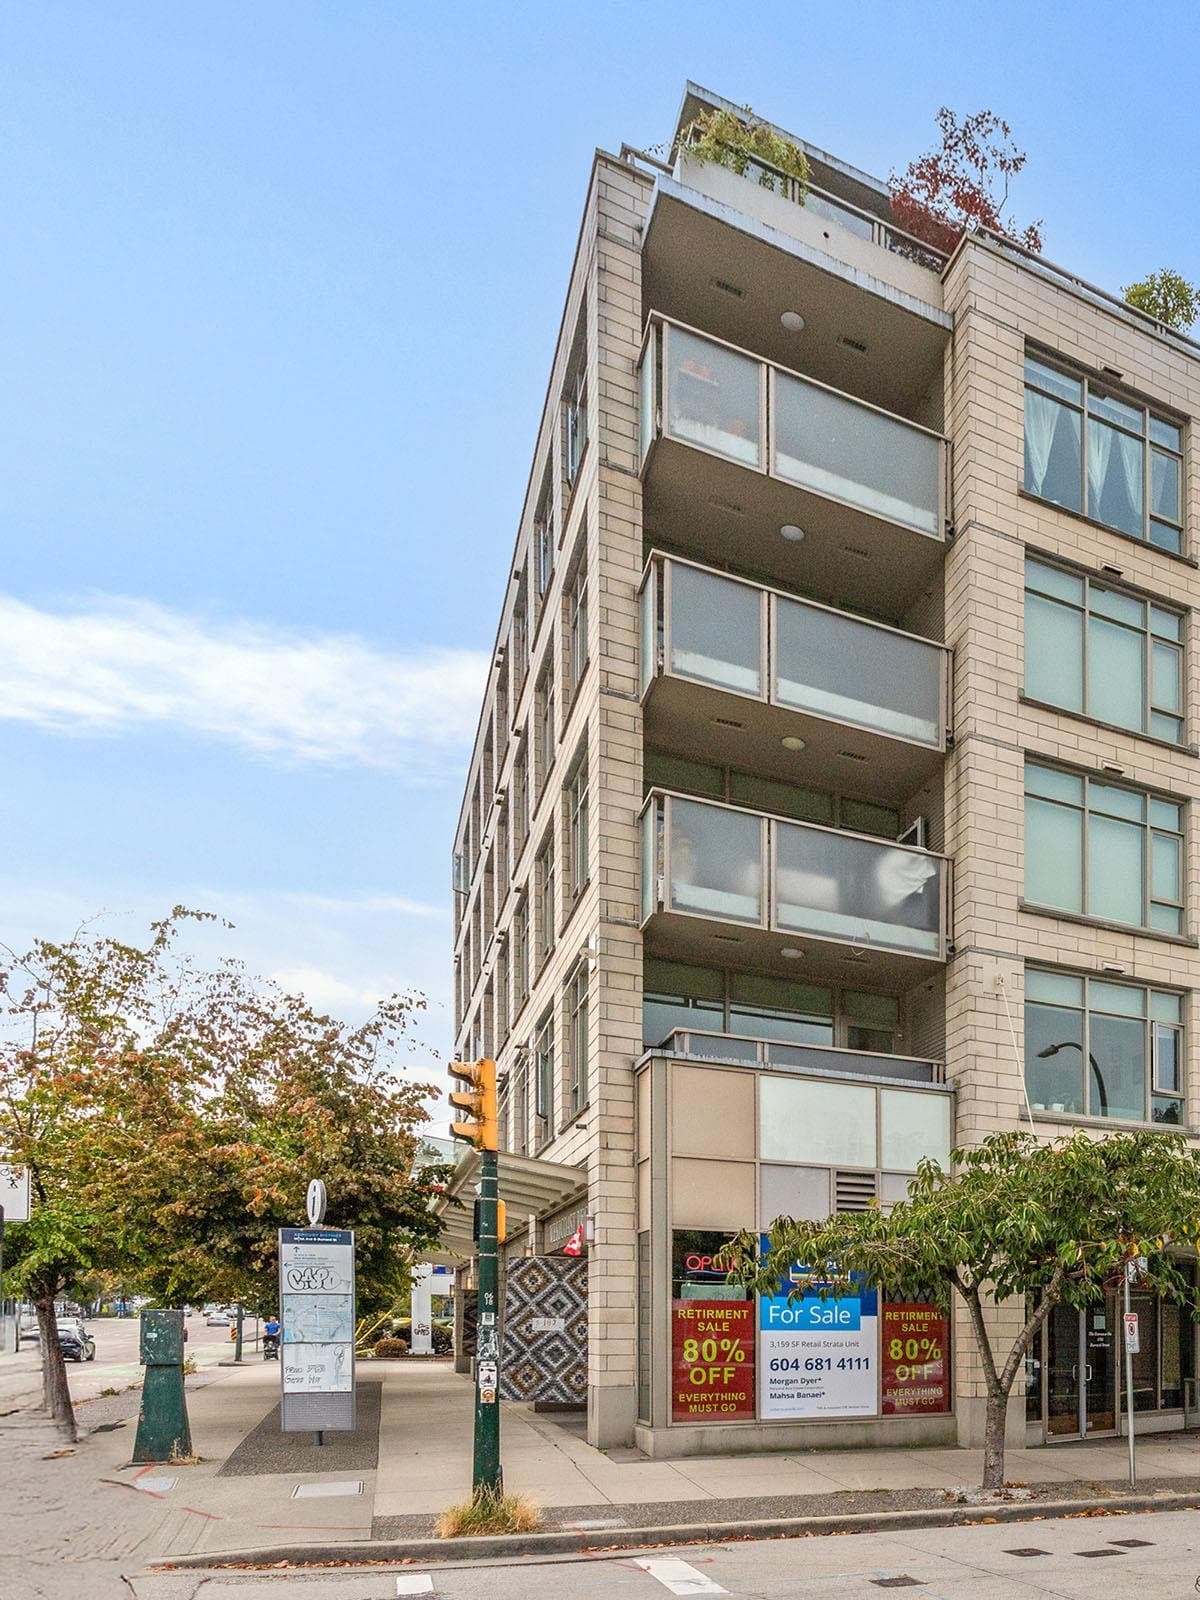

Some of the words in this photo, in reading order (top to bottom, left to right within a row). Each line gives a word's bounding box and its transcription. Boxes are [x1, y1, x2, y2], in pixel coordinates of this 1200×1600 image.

[678, 1309, 749, 1319] RETIRMENT
[769, 1305, 803, 1324] For
[809, 1305, 851, 1324] Sale
[697, 1322, 730, 1332] SALE
[901, 1323, 929, 1332] SALE
[769, 1340, 790, 1349] 3,159
[802, 1340, 821, 1348] Retail
[822, 1340, 844, 1348] Strata
[845, 1340, 860, 1348] Unit
[889, 1338, 942, 1361] 80%
[683, 1338, 746, 1363] 80%
[769, 1358, 800, 1372] 604
[804, 1358, 832, 1371] 681
[836, 1357, 870, 1370] 4111
[689, 1367, 736, 1385] OFF
[895, 1364, 934, 1381] OFF
[769, 1378, 799, 1386] Morgan
[678, 1392, 747, 1402] EVERYTHING
[886, 1387, 943, 1397] EVERYTHING
[895, 1397, 920, 1407] MUST
[921, 1397, 935, 1405] GO
[689, 1404, 719, 1413] MUST
[720, 1403, 737, 1412] GO
